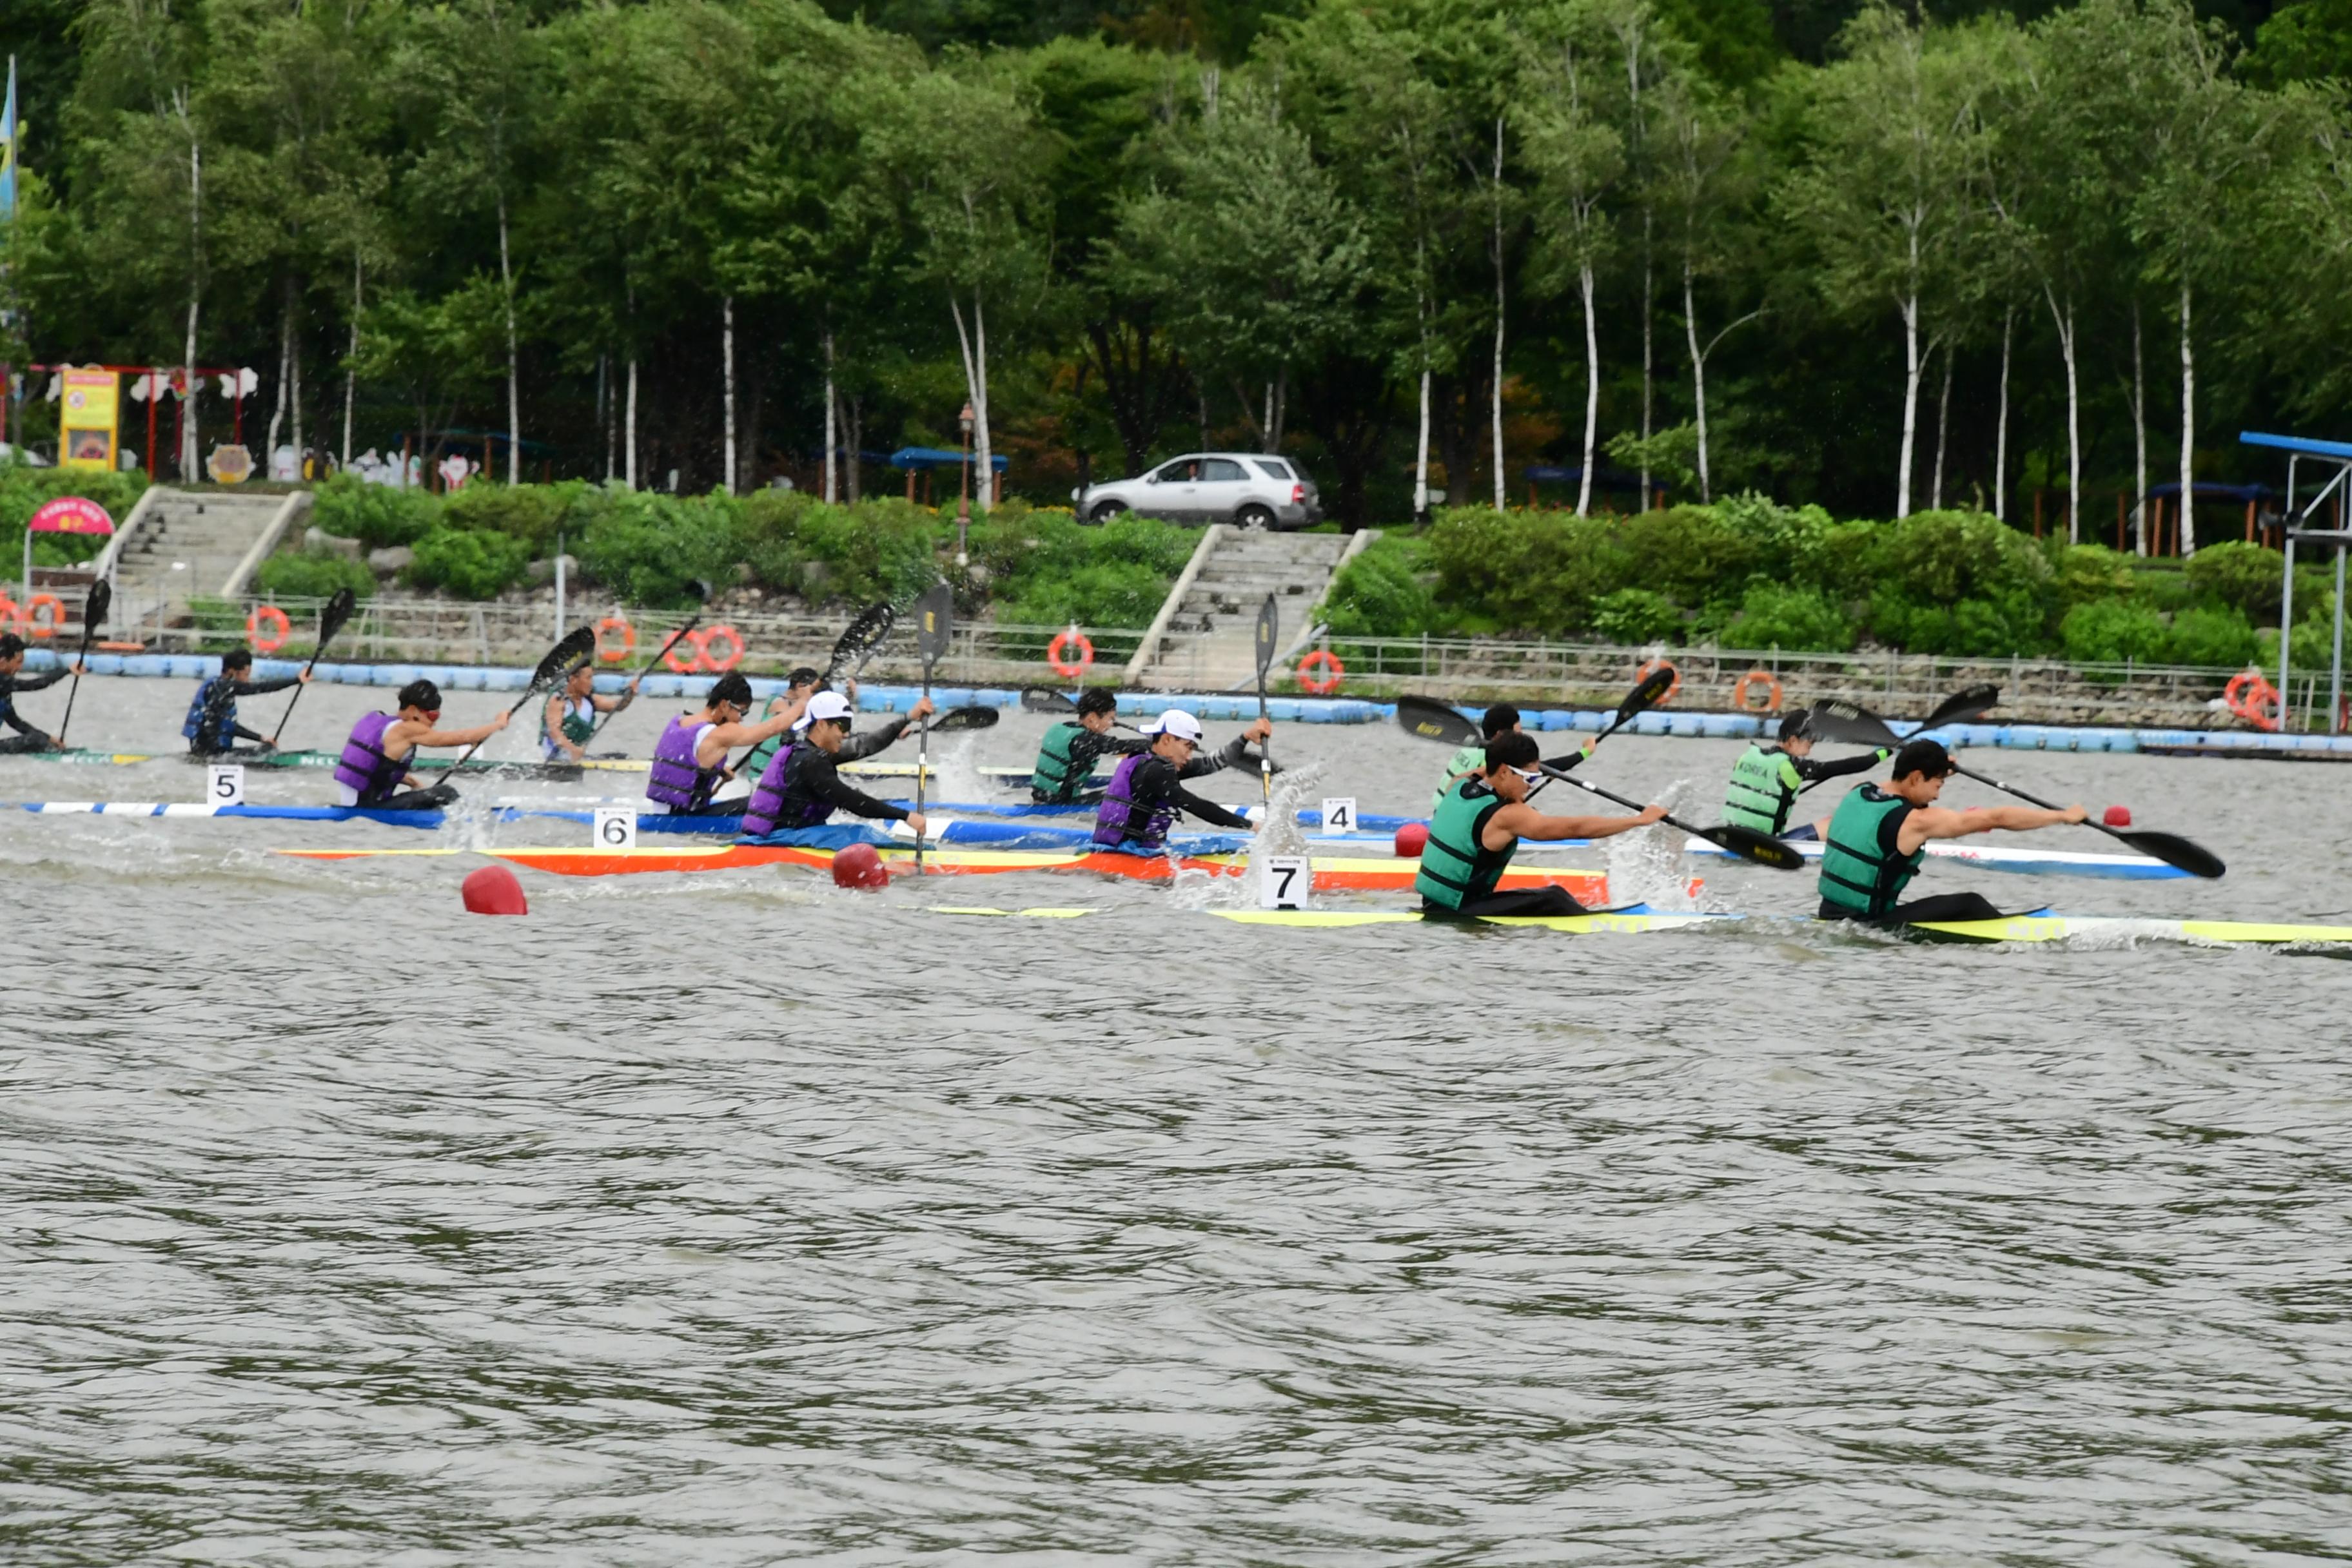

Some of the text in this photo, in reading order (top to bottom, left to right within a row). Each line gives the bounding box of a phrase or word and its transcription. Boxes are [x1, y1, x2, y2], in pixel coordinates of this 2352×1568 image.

[216, 774, 235, 798] 5
[1330, 806, 1349, 828] 4
[603, 817, 627, 845] 6
[1271, 868, 1297, 899] 7
